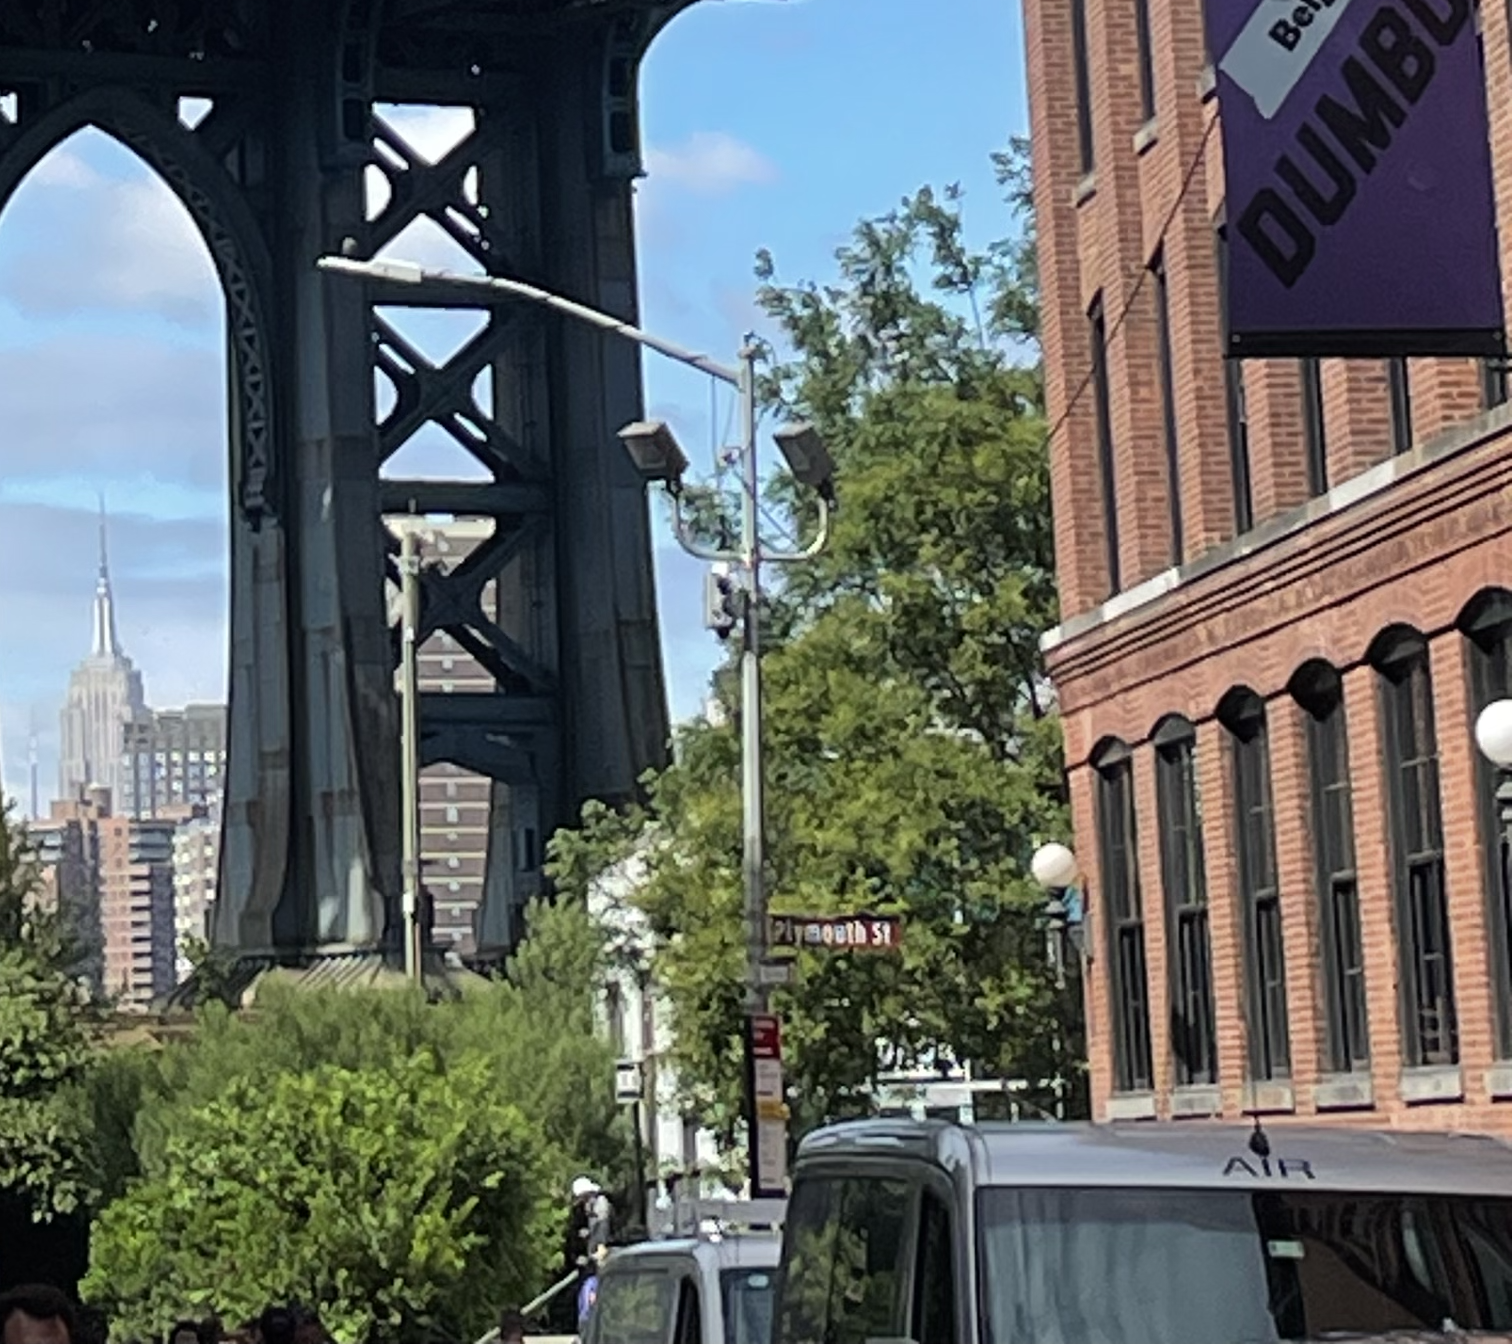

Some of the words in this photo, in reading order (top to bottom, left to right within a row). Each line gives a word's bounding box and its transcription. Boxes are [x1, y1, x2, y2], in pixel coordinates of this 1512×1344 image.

[773, 919, 868, 947] Plymouth
[871, 920, 891, 946] St
[1222, 1156, 1316, 1180] AIR
